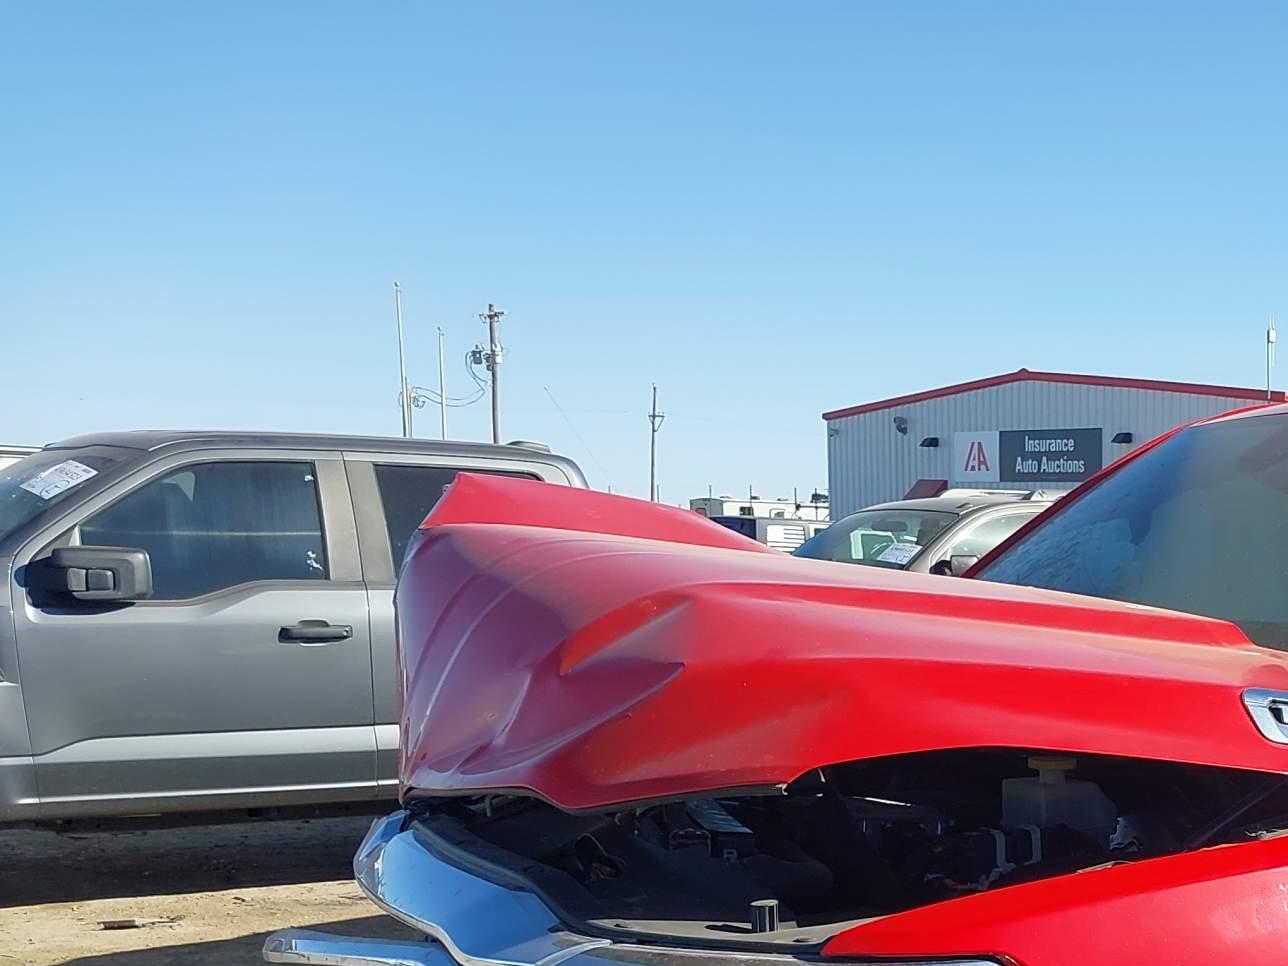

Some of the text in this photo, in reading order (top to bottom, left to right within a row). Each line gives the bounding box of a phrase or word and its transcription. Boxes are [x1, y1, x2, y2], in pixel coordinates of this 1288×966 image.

[1025, 436, 1075, 452] Insurance
[1015, 456, 1085, 473] Auto Auctions
